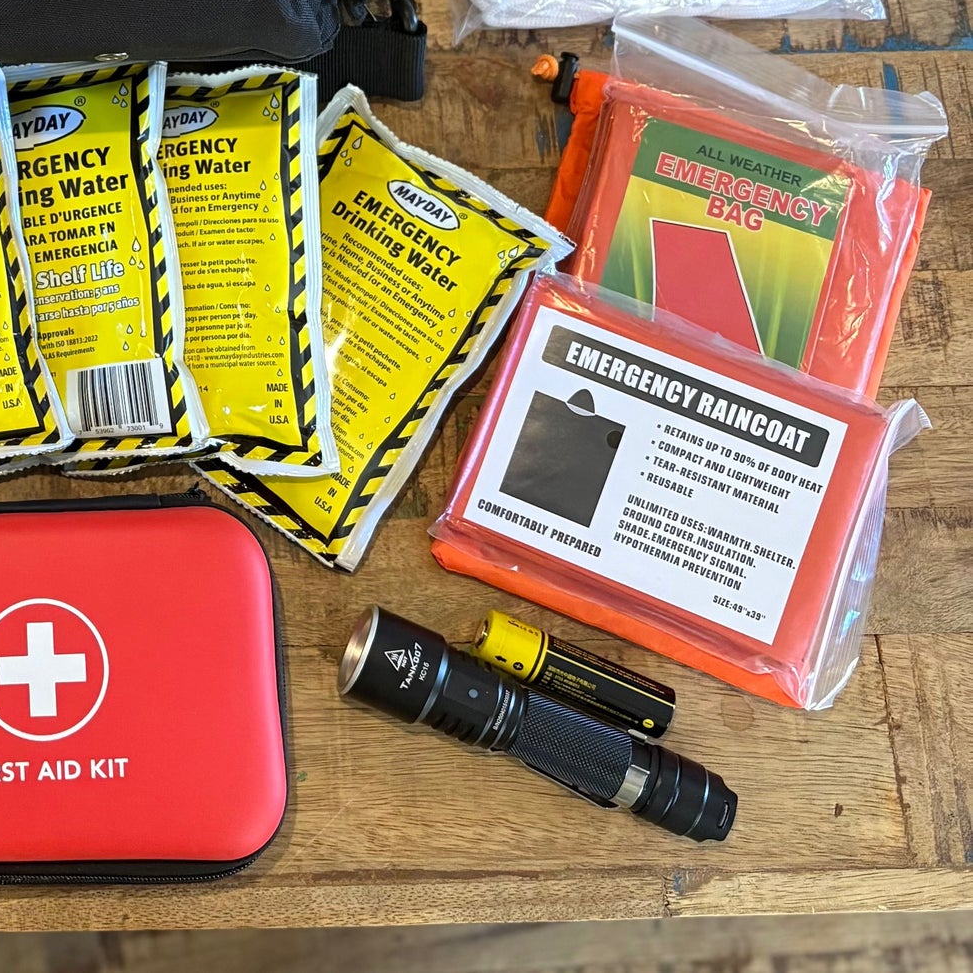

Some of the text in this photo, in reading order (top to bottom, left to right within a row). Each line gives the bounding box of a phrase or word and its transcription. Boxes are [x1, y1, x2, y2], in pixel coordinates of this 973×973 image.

[195, 159, 250, 175] Water
[695, 144, 801, 187] ALL WEATHER
[59, 174, 128, 200] Water
[170, 194, 208, 204] Business
[222, 190, 260, 201] Anytime
[654, 152, 830, 226] EMERGENCY
[50, 202, 123, 224] D'URGENCE
[180, 204, 192, 213] for
[208, 203, 258, 212] Emergency
[393, 186, 454, 224] MAYDAY
[706, 194, 764, 231] BAG
[50, 224, 96, 244] TOMAR
[353, 190, 462, 267] EMERGENCY
[34, 239, 118, 264] EMERGENCIA
[331, 200, 406, 258] Drinking
[406, 247, 458, 292] Water
[342, 232, 403, 276] Recommended
[402, 274, 423, 291] uses:
[36, 260, 125, 290] Shelf Life
[330, 248, 437, 328] is Needed for an Emergency
[333, 242, 364, 264] Home,
[365, 260, 401, 288] Business
[401, 286, 411, 295] or
[410, 292, 445, 321] Anytime
[34, 289, 94, 306] onservation:
[102, 284, 120, 294] ans
[108, 302, 115, 312] 5
[116, 296, 140, 310] años
[6, 383, 14, 392] IN
[266, 384, 288, 392] MADE
[565, 340, 810, 452] EMERGENCY RAINCOAT
[274, 400, 282, 408] IN
[658, 440, 790, 499] COMPACT AND LIGHTWEIGHT
[663, 424, 704, 446] RETAINS
[705, 440, 718, 451] UP
[720, 446, 732, 457] TO
[732, 451, 755, 467] 90%
[757, 461, 770, 472] OF
[798, 477, 823, 493] HEAT
[328, 487, 336, 497] IN
[646, 472, 694, 498] REUSABLE
[653, 456, 779, 513] TEAR-RESISTANT MATERIAL
[622, 506, 662, 529] GROUND
[627, 494, 679, 521] UNLIMITED
[477, 498, 601, 557] COMFORTABLY PREPARED
[613, 531, 741, 590] HYPOTHERMIA PREVENTION
[709, 556, 746, 578] SIGNAL.
[38, 760, 81, 781] AID
[90, 758, 128, 778] KIT
